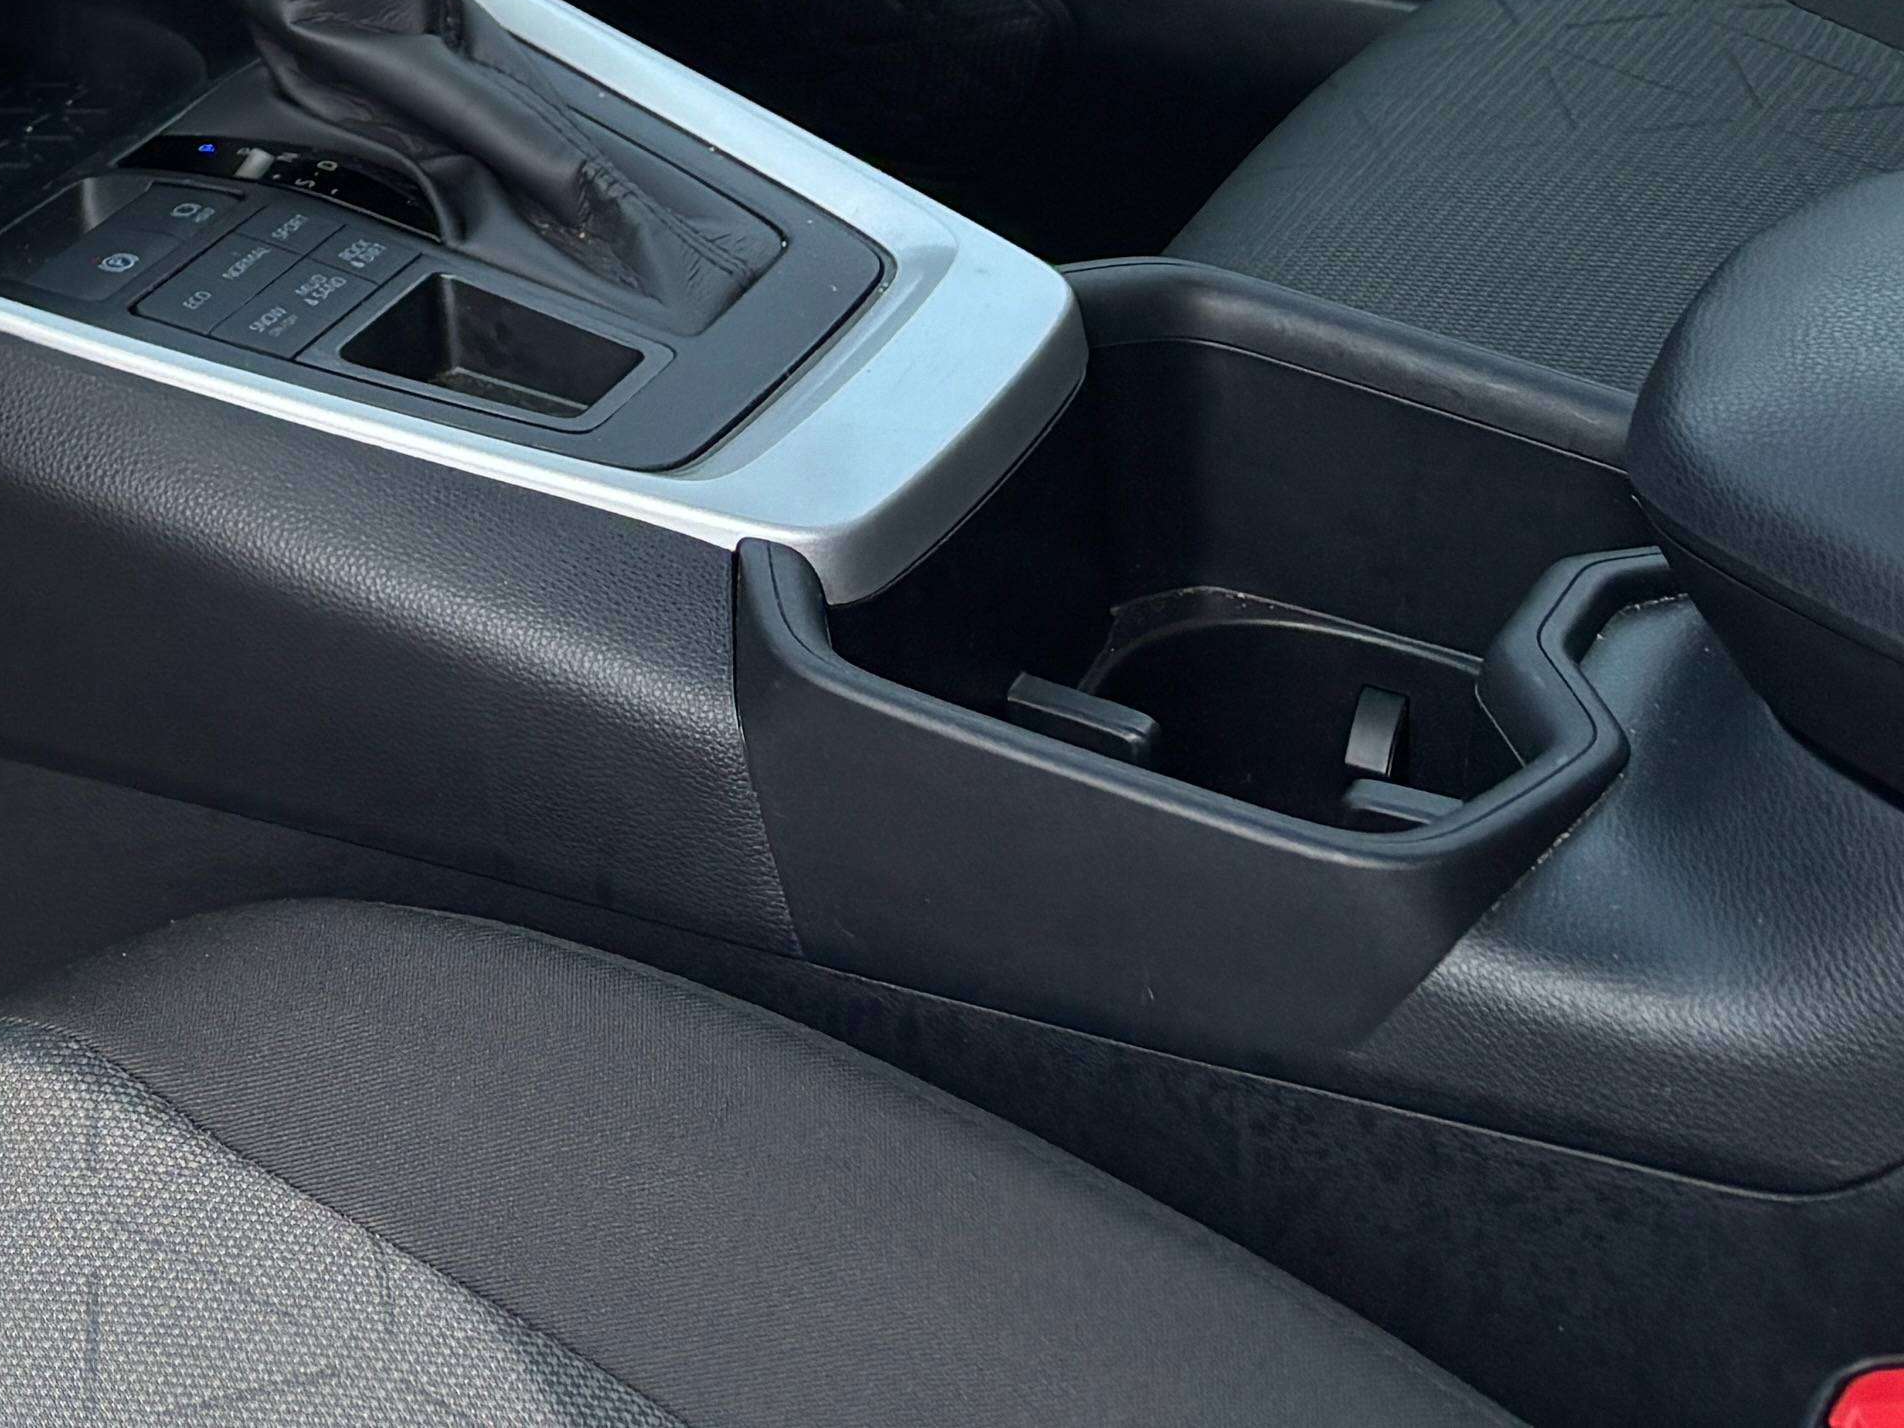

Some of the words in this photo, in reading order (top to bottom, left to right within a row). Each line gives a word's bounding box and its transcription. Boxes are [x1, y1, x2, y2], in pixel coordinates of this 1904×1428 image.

[221, 245, 273, 281] NORMAL
[182, 290, 213, 311] ECO
[248, 306, 288, 334] SNOW
